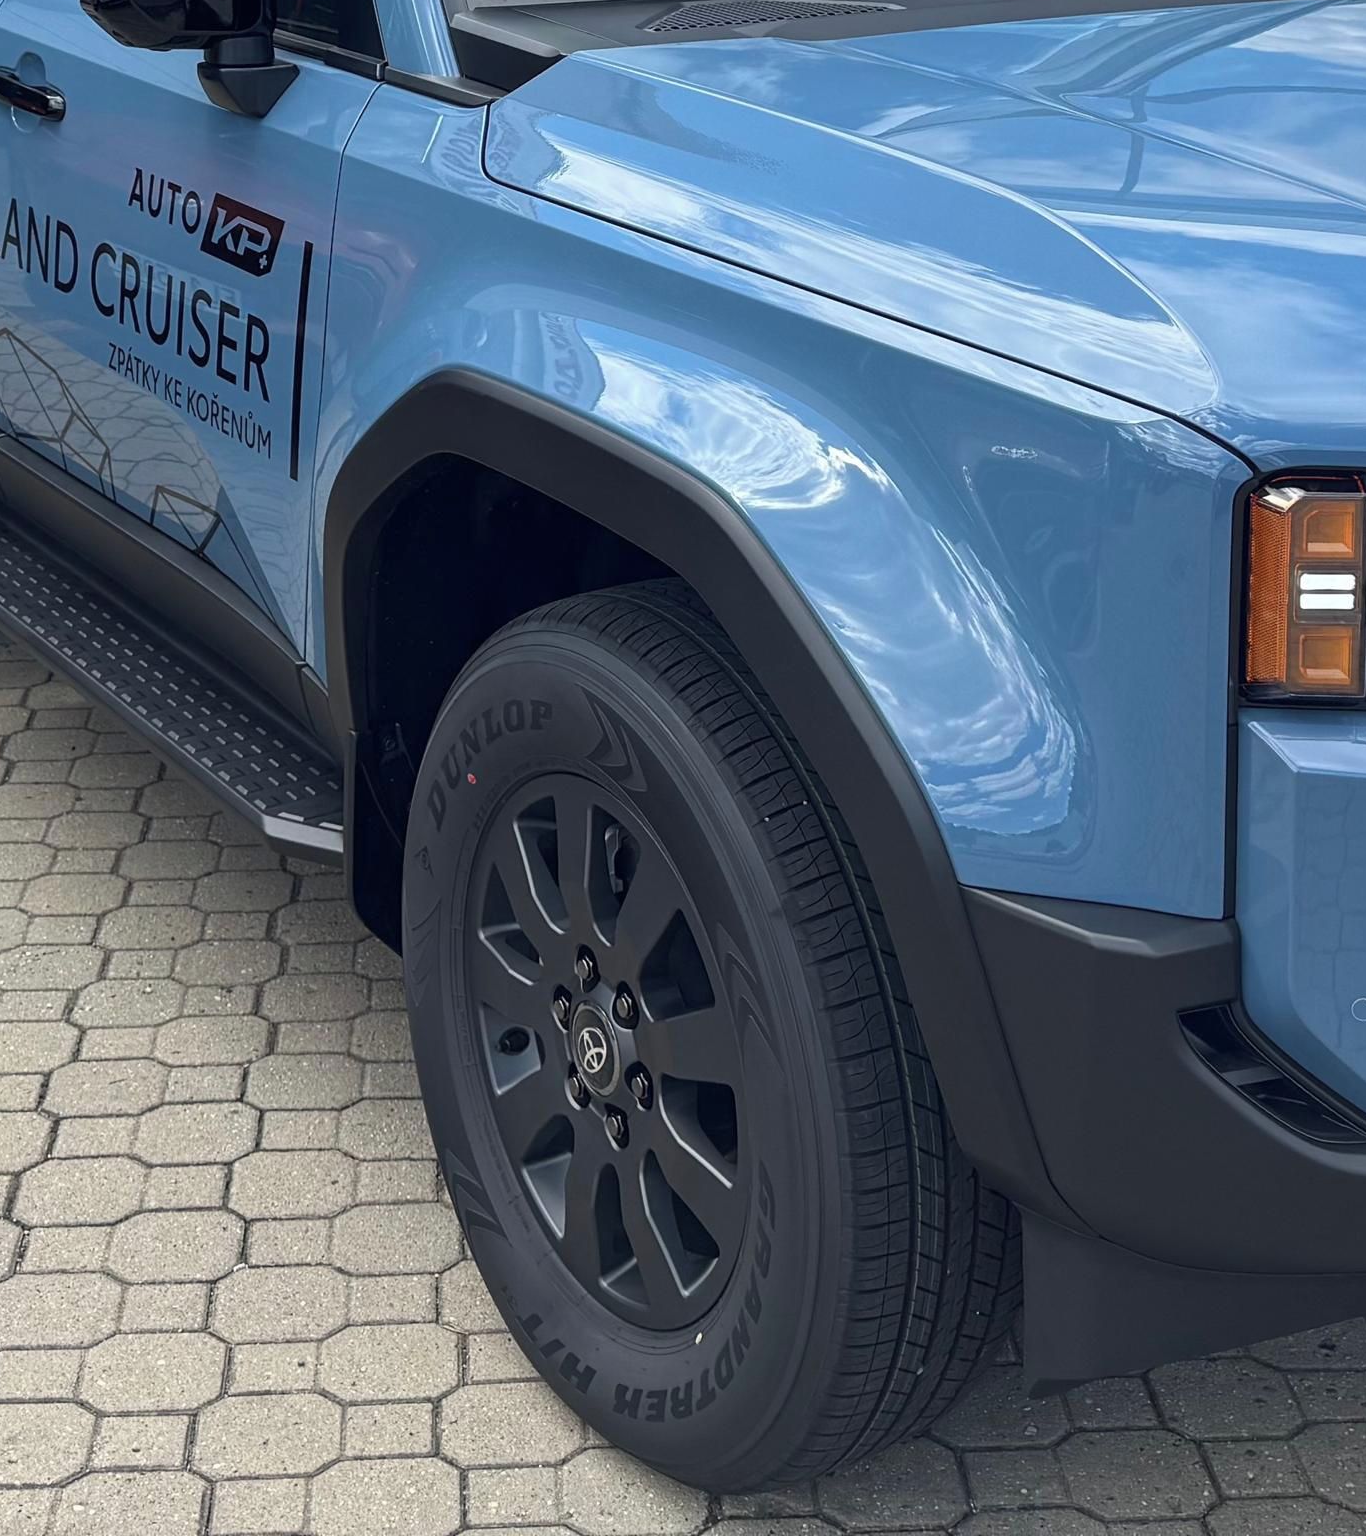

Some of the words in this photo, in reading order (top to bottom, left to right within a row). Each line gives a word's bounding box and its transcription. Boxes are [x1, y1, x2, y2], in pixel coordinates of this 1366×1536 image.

[128, 167, 202, 234] AUTO
[90, 241, 271, 404] CRUISER
[108, 342, 161, 394] ZPÁTKY
[163, 373, 183, 409] KE
[186, 388, 272, 459] KOŘENŮM
[427, 699, 553, 833] DUNLOP
[611, 1158, 777, 1424] GRANDTREK
